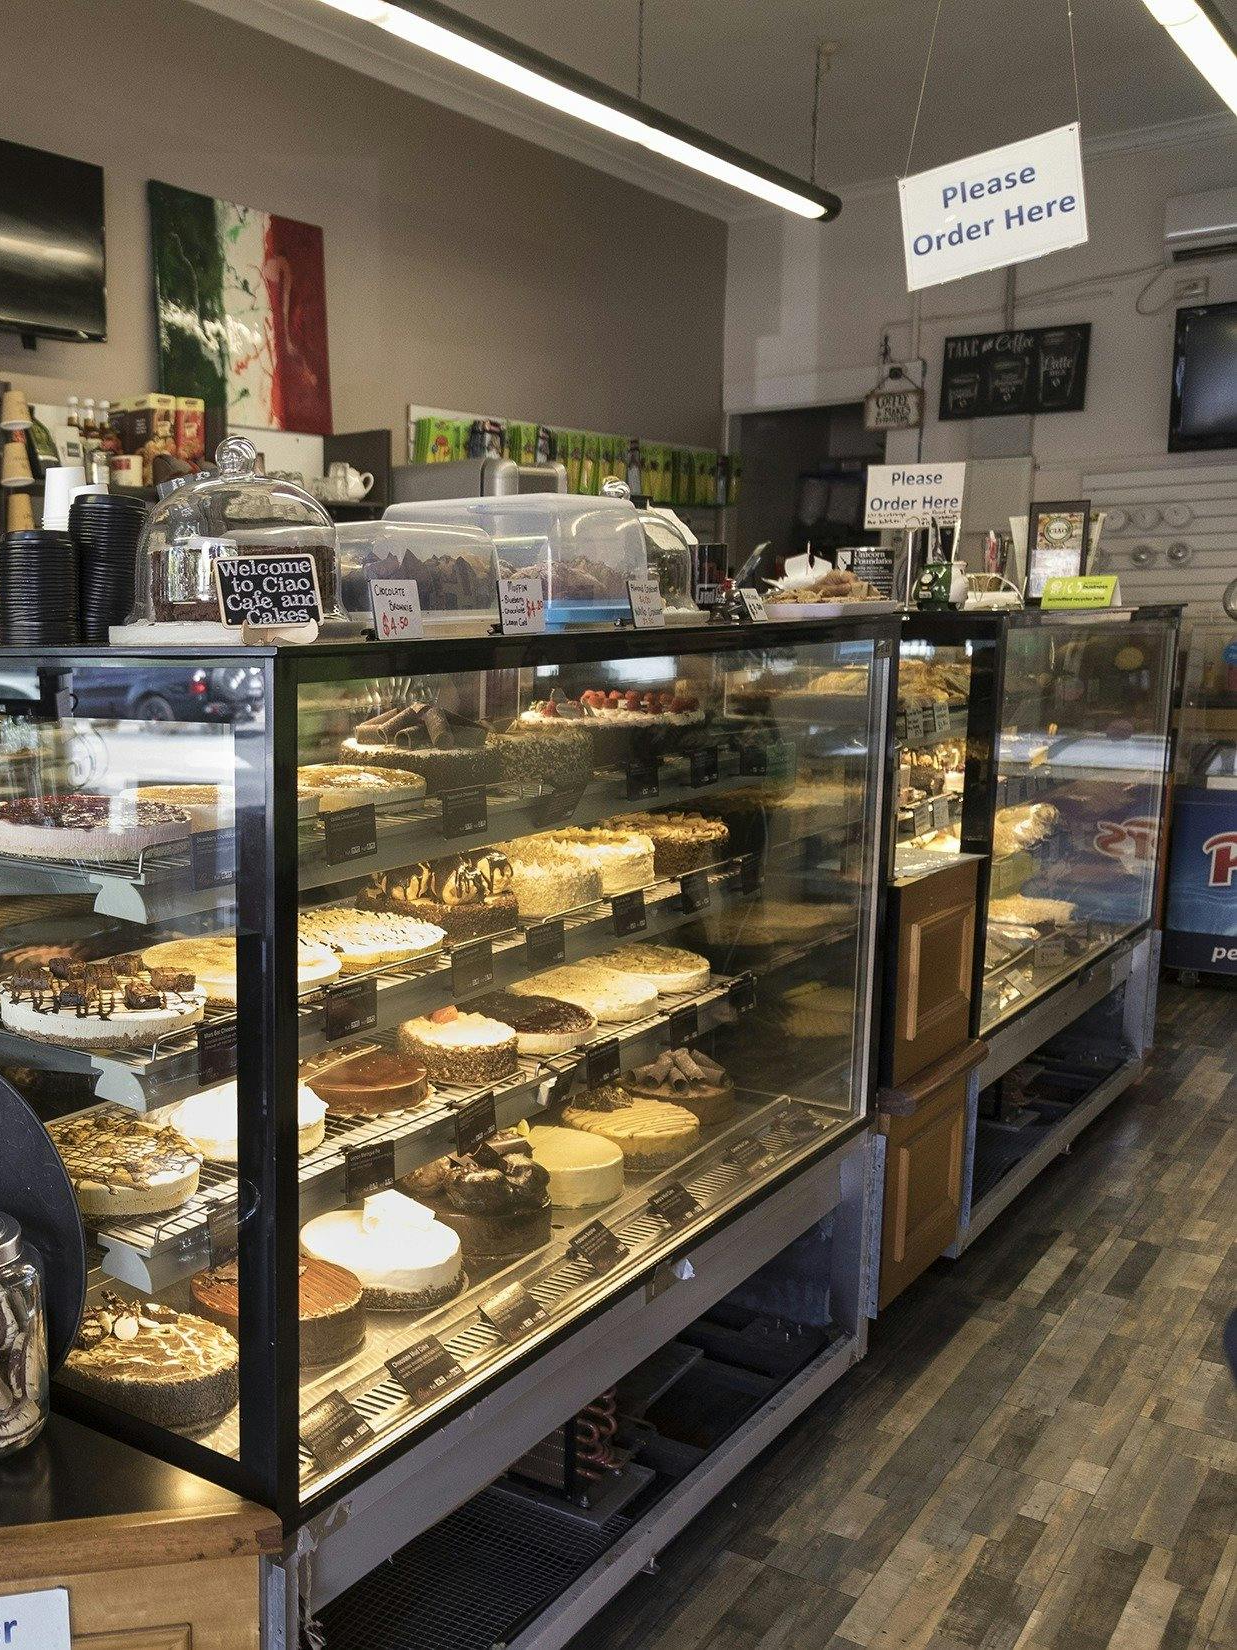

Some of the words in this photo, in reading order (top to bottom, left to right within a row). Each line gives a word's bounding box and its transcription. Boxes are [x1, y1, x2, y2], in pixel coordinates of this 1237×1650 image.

[942, 166, 1036, 209] Please
[913, 218, 994, 257] Order
[1004, 194, 1076, 230] Here
[891, 471, 943, 486] Please
[870, 497, 918, 511] Order
[922, 496, 959, 509] Here
[217, 560, 311, 577] Welcome
[231, 577, 254, 592] to
[262, 576, 311, 593] Ciao
[226, 590, 273, 611] Cafe
[281, 590, 320, 608] and
[246, 607, 310, 626] Cakes
